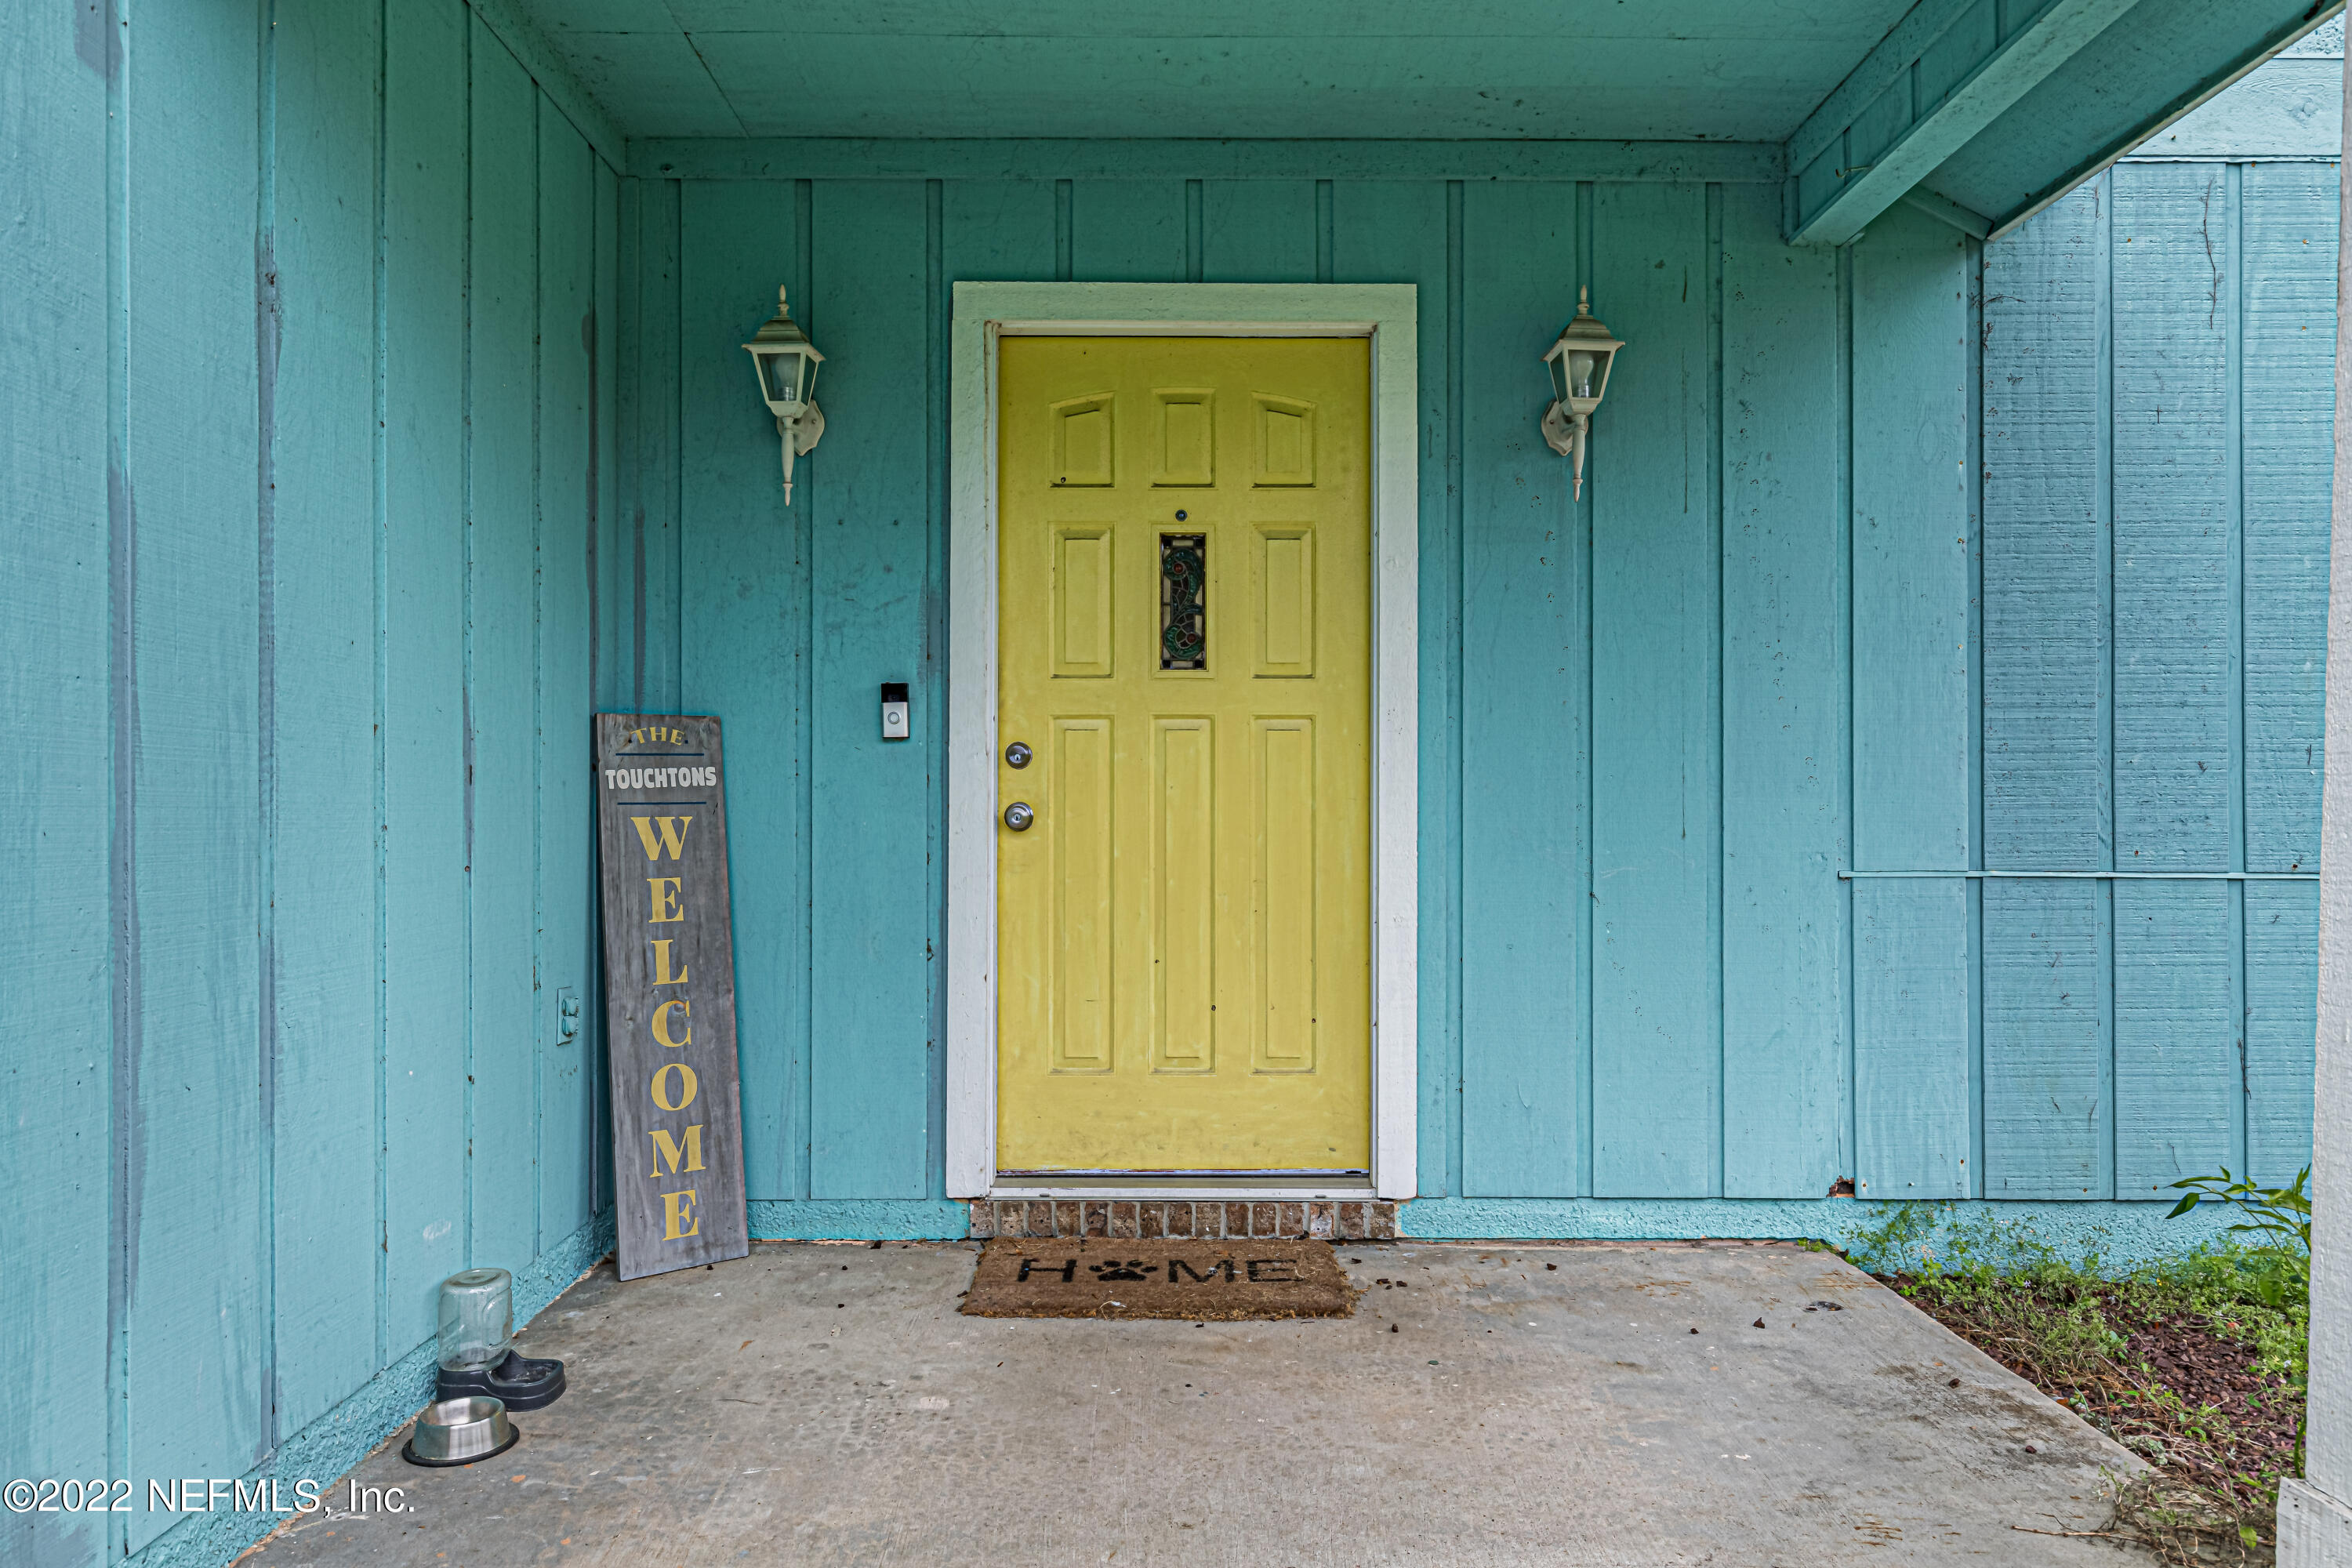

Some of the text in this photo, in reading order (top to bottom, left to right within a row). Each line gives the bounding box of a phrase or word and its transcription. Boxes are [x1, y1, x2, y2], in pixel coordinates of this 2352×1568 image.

[630, 727, 684, 746] THE
[604, 766, 717, 789] TOUCHTONS
[630, 815, 706, 1241] WELCOME
[1016, 1258, 1304, 1283] HME
